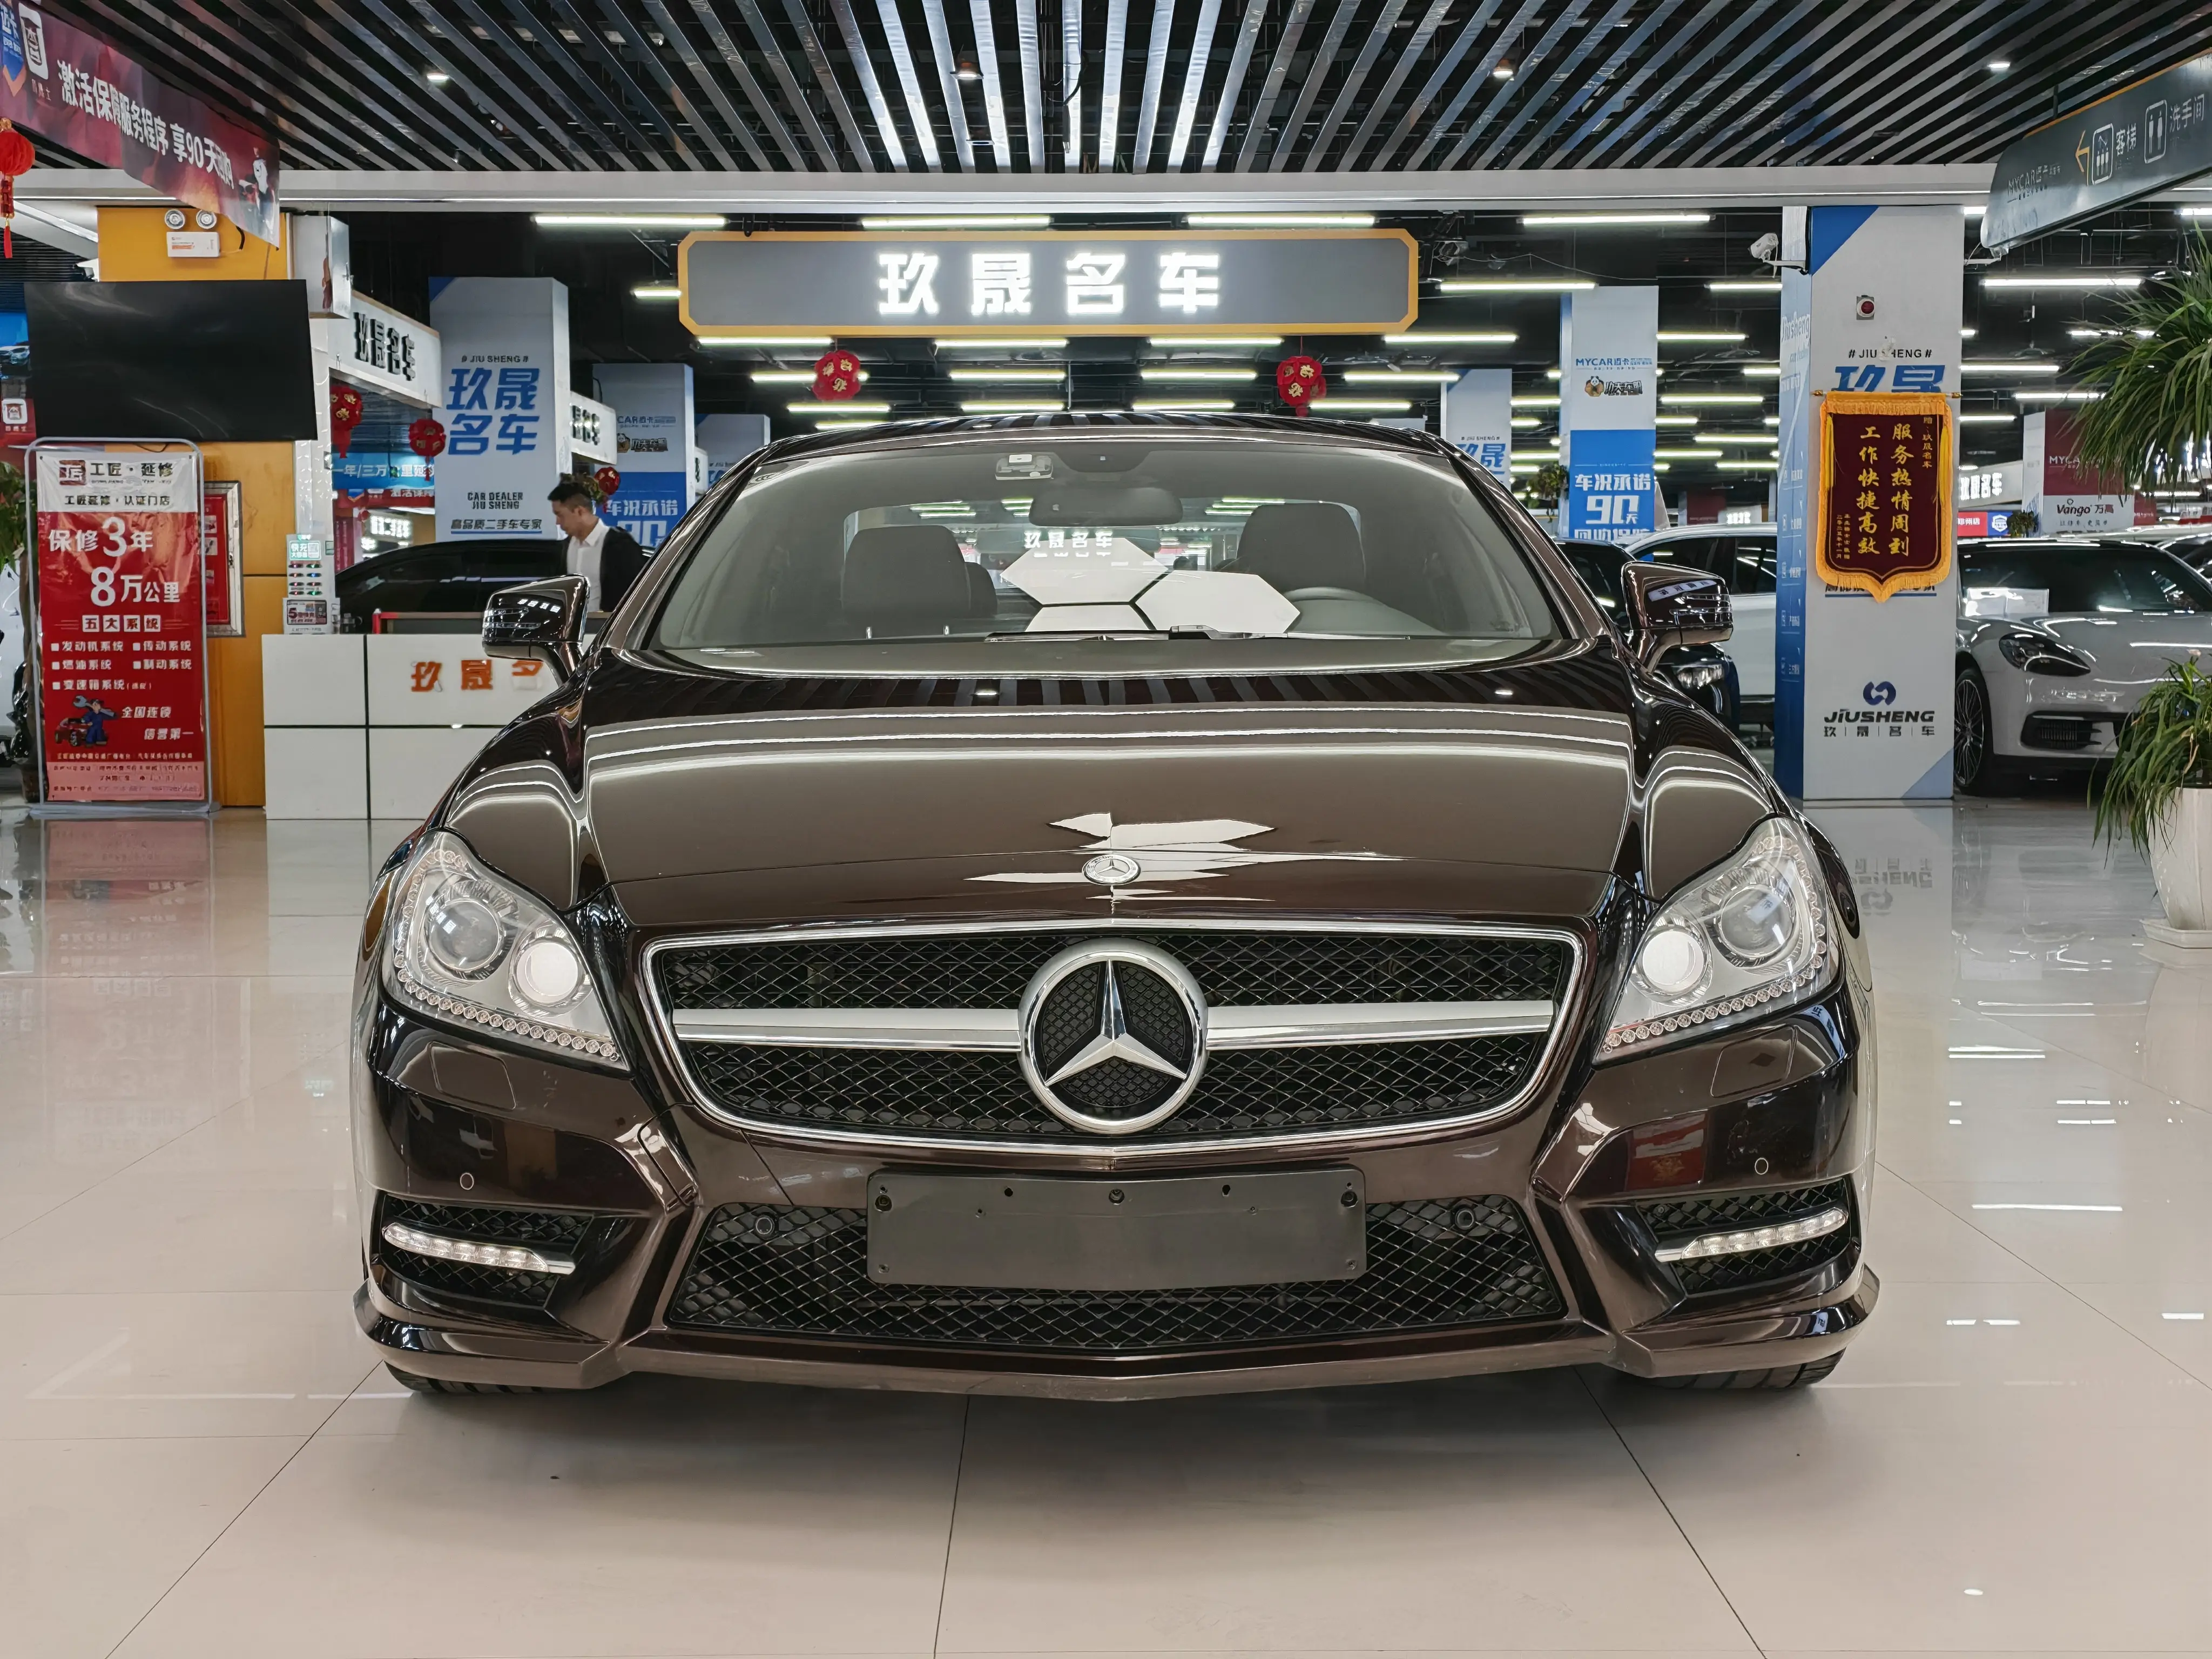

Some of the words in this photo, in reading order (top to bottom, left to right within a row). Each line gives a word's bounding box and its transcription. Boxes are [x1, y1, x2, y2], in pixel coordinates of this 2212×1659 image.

[2170, 93, 2204, 132] 洗手间
[2115, 123, 2137, 156] 客梯
[878, 251, 1219, 315] 玖晟名车
[353, 312, 416, 381] 玖晟名车
[1859, 349, 1877, 358] JIU
[1880, 349, 1921, 358] HENG
[447, 368, 540, 410] 玖晟
[448, 414, 540, 455] 名车
[1575, 473, 1651, 491] 车况承诺
[1856, 426, 1880, 555] 工作快捷高效
[1889, 423, 1914, 557] 服务热情周到
[473, 501, 485, 509] JIU
[489, 501, 519, 509] SHENG
[606, 500, 678, 516] 车况承诺
[1586, 495, 1638, 524] 90天
[2057, 504, 2090, 517] Vango
[48, 516, 153, 557] 保修3年
[451, 520, 542, 530] 高品质二手车专家
[90, 567, 181, 607] 8万公里
